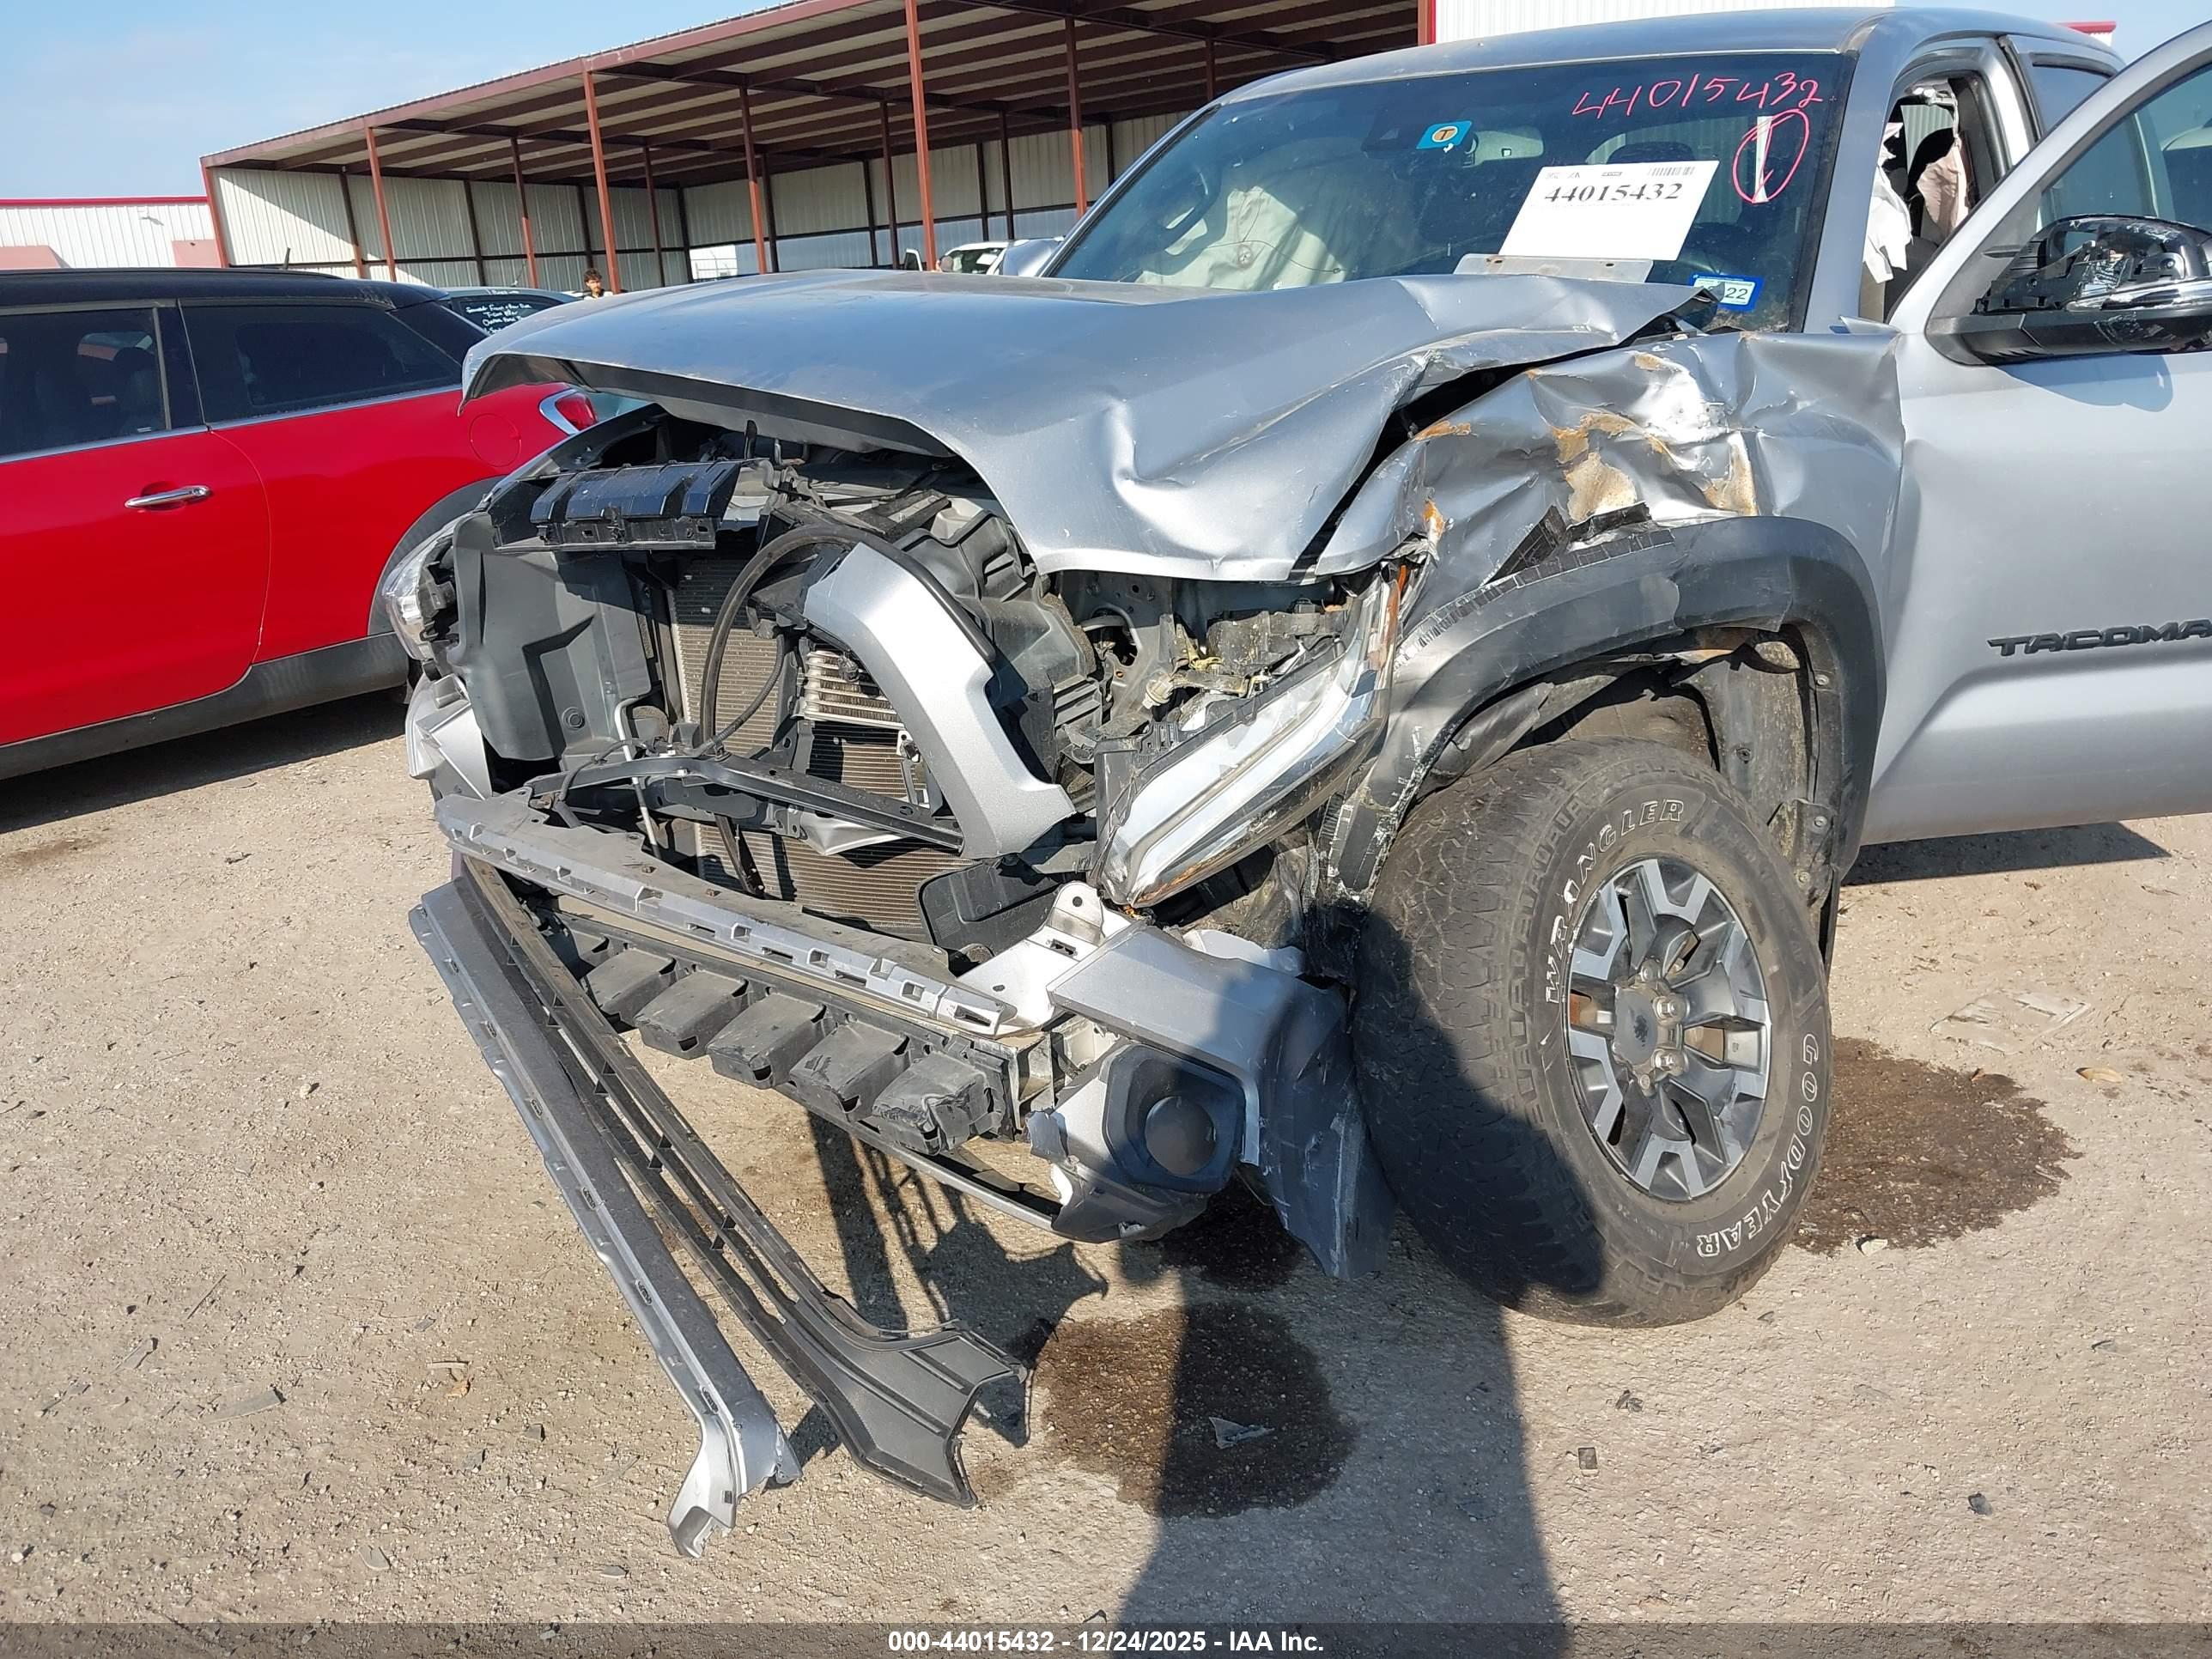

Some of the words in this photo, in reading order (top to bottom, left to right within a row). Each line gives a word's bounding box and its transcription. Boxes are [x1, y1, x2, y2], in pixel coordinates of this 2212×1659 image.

[1571, 72, 1824, 119] 44015432
[1544, 183, 1683, 203] 44015432
[1987, 618, 2212, 657] TACOMA
[1546, 799, 1684, 1004] WRANGLER
[1697, 1033, 1819, 1257] GOODYEAR
